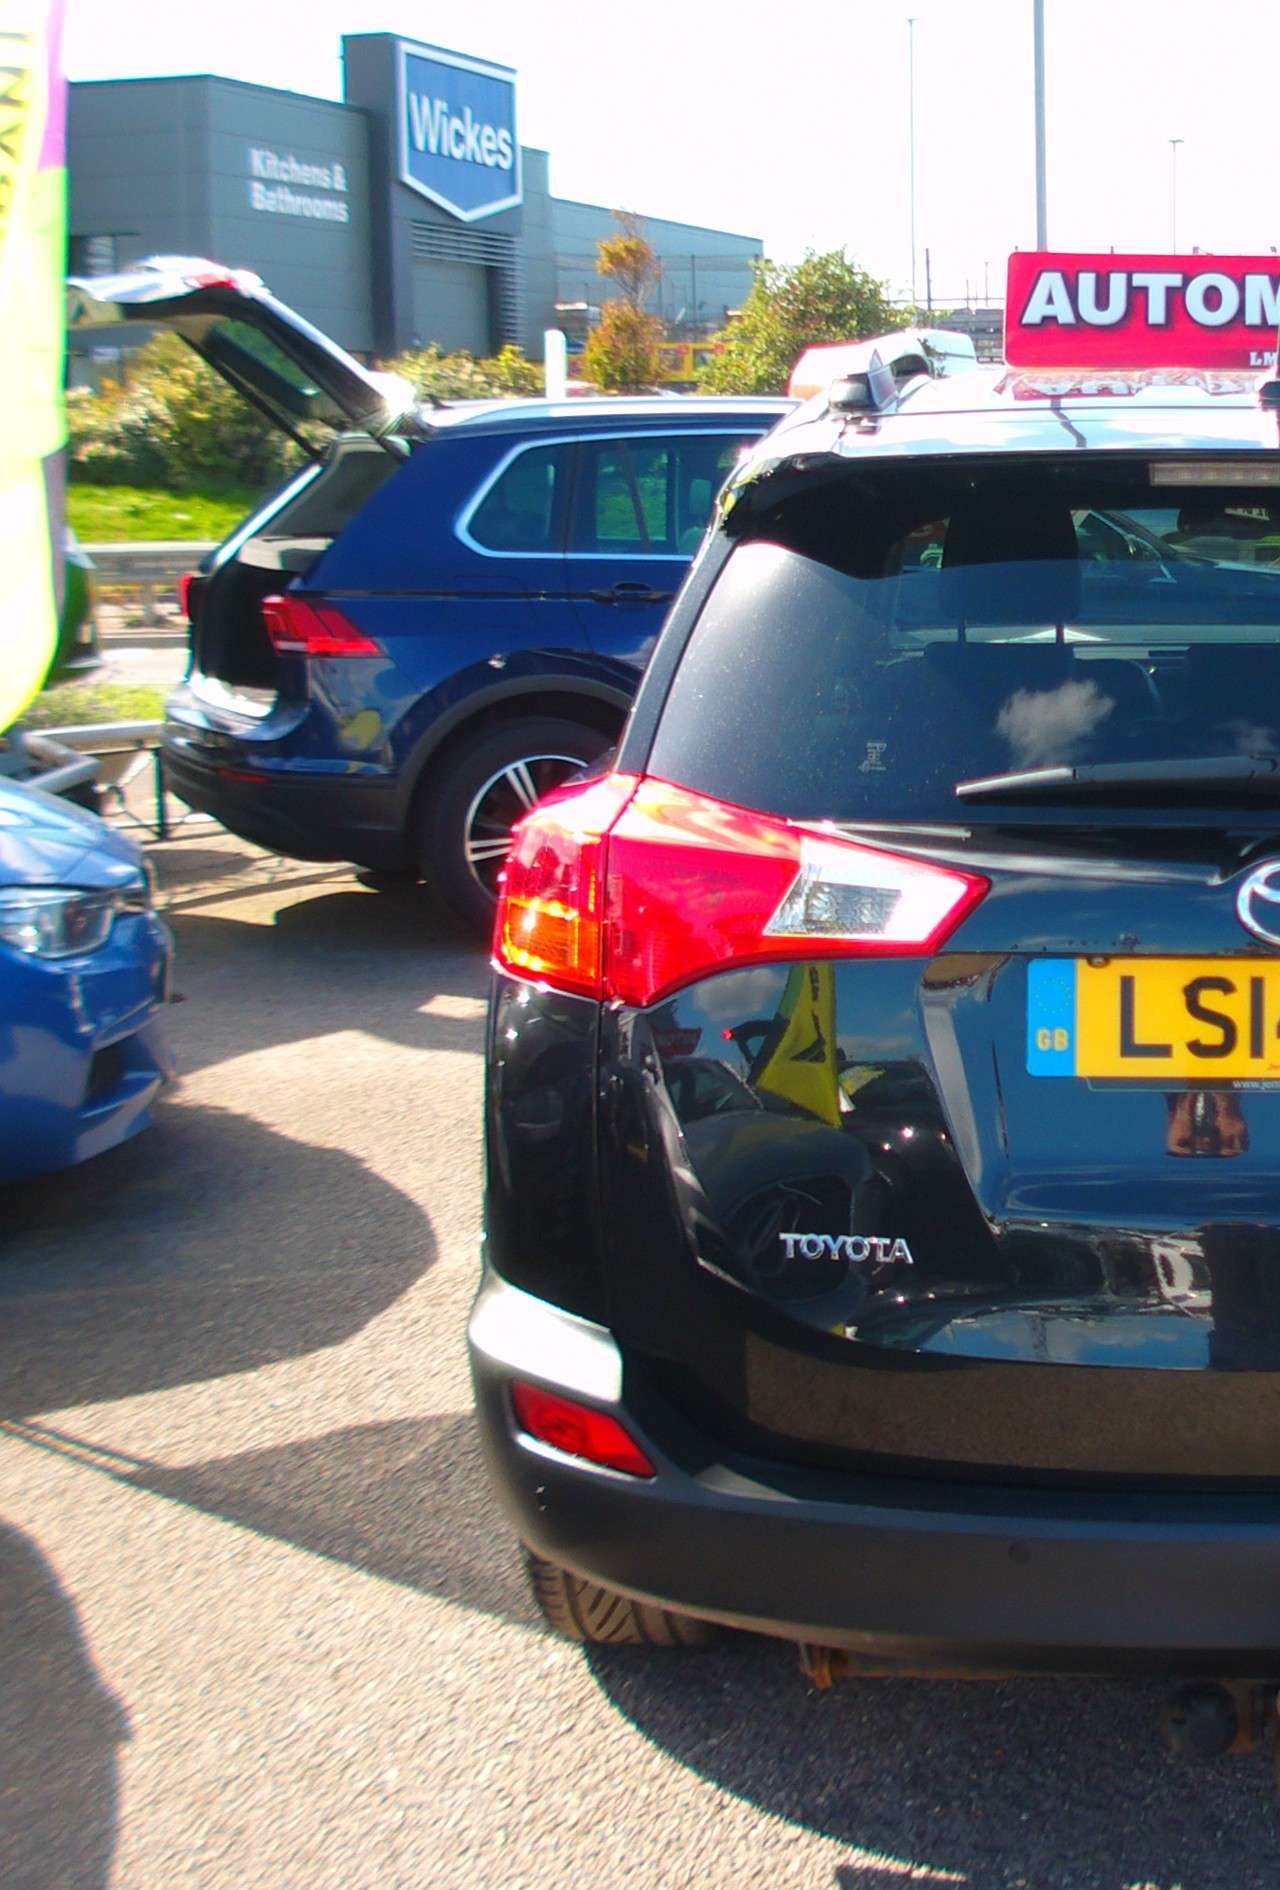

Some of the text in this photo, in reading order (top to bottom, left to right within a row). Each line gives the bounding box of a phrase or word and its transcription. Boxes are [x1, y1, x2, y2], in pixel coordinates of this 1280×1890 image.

[410, 93, 513, 170] Wickes
[251, 149, 348, 192] Kitchens &
[252, 180, 350, 223] Bathrooms
[1036, 1030, 1069, 1052] GB
[778, 1232, 914, 1265] TOYOTA
